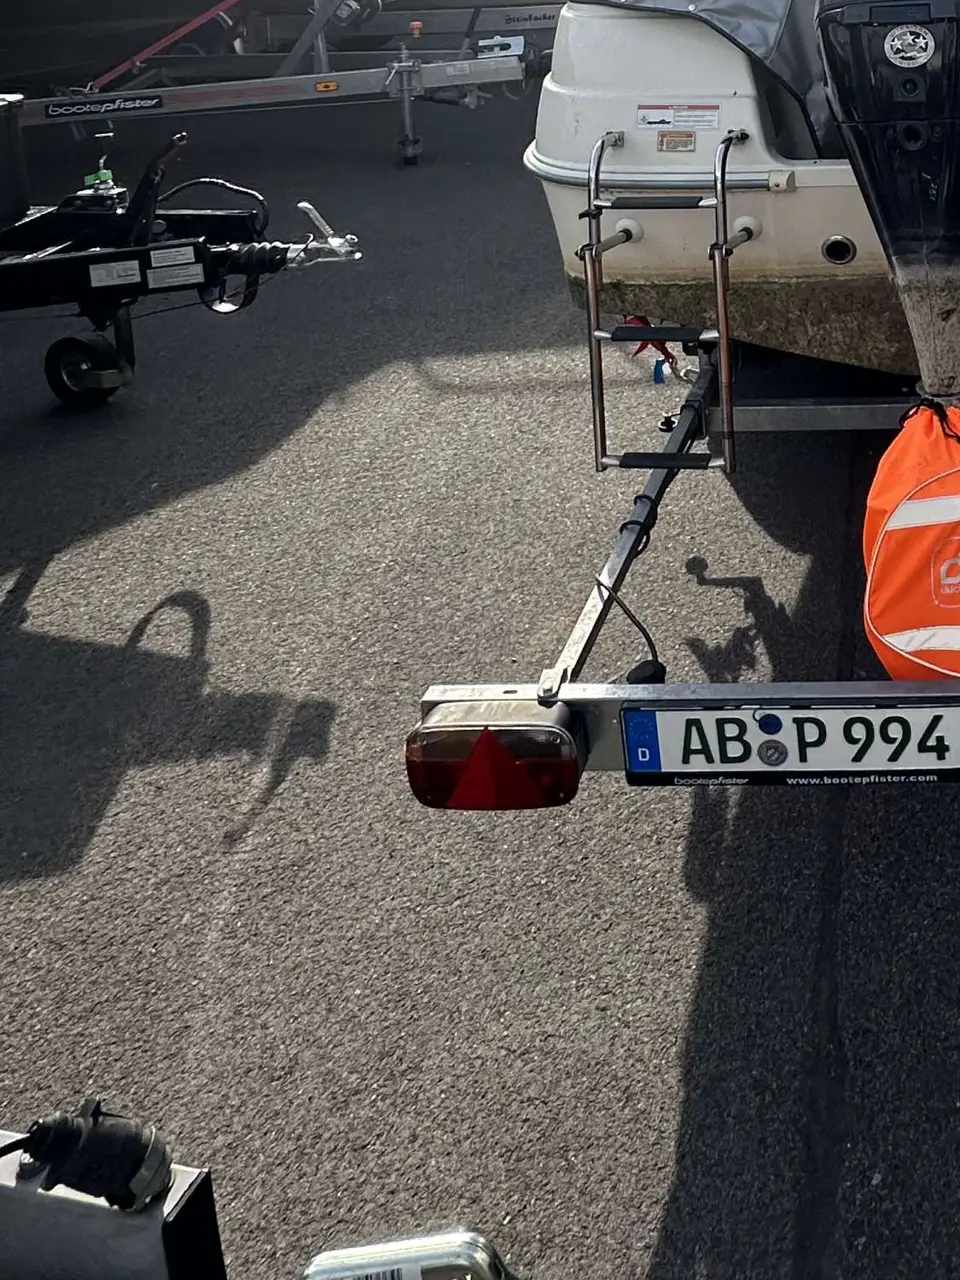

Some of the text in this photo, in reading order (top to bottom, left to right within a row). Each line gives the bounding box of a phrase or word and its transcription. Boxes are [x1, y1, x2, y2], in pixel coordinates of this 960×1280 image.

[48, 99, 160, 116] bootepfister
[681, 714, 950, 765] AB P 994
[637, 747, 650, 762] D
[786, 773, 939, 786] www.bootepfister.com
